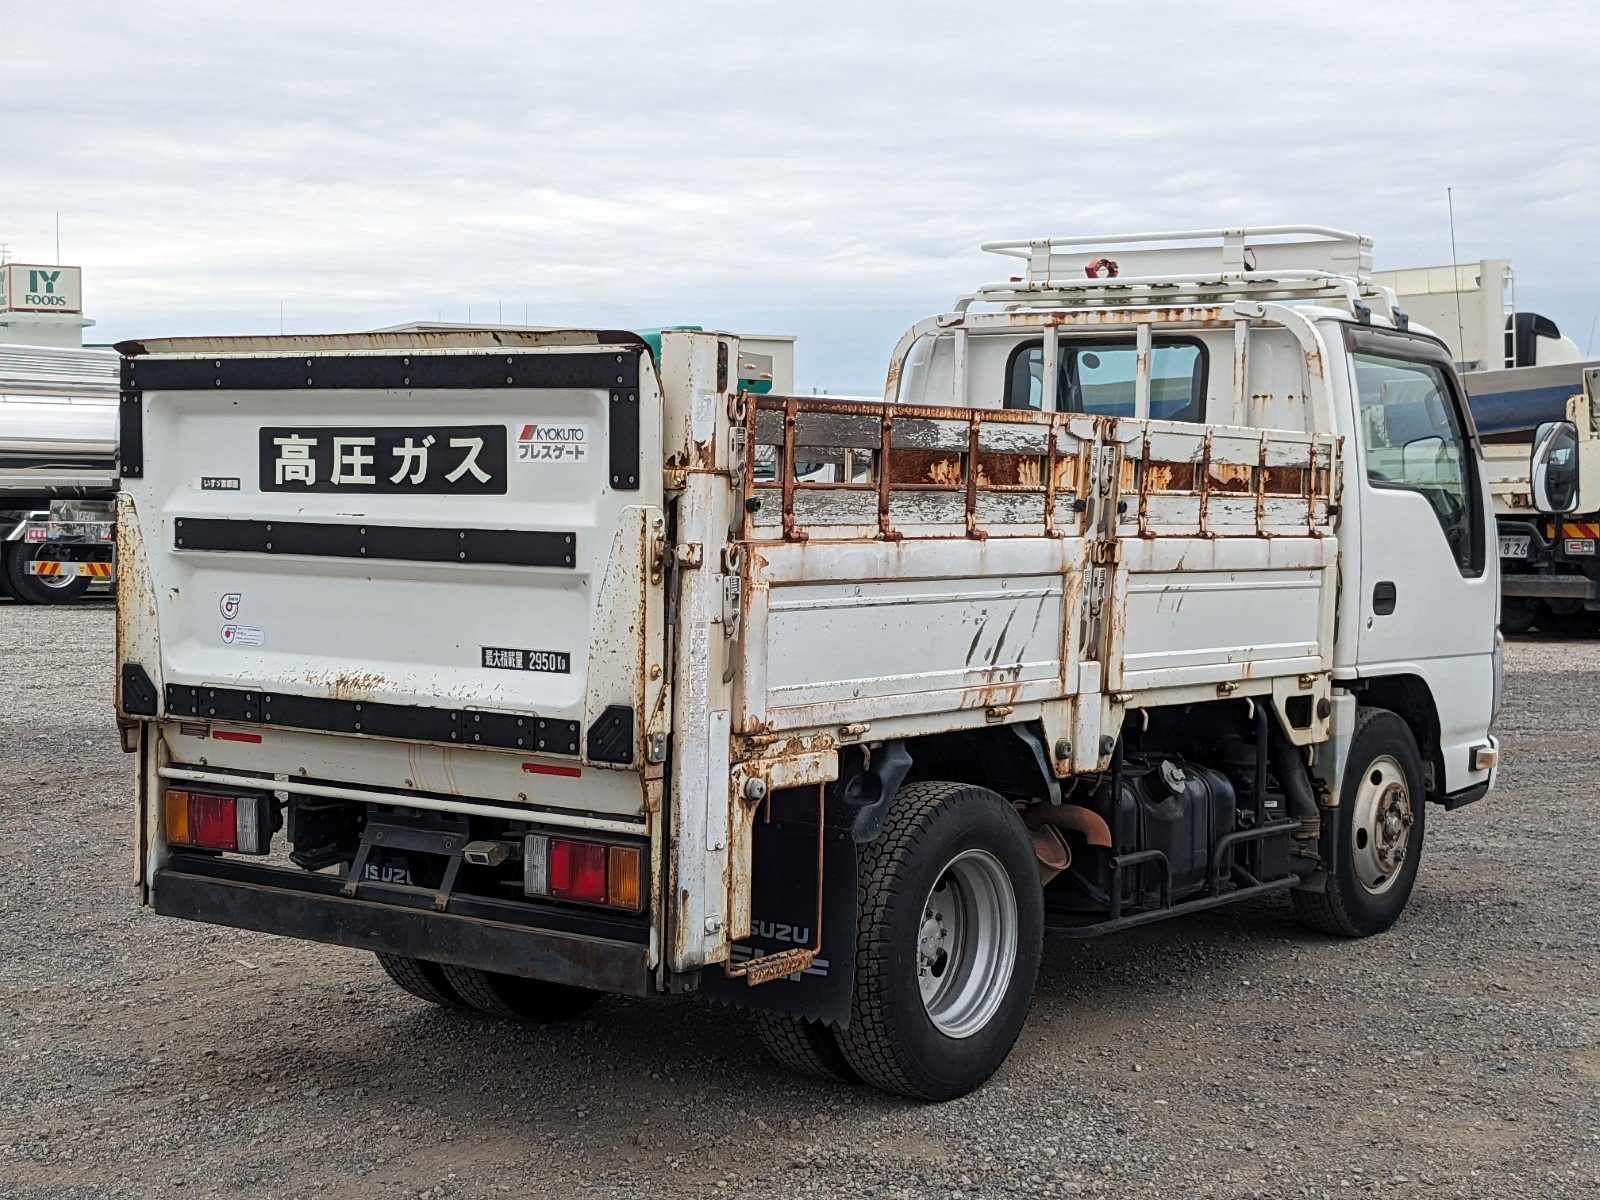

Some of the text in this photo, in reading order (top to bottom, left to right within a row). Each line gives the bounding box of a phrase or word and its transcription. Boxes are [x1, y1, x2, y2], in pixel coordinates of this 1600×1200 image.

[30, 270, 61, 293] IY
[25, 295, 66, 306] FOODS
[537, 428, 584, 441] KYOKUTO
[273, 433, 492, 487] 高圧ガス
[518, 444, 585, 460] プレスゲート
[485, 650, 523, 669] 最大積載量
[750, 919, 809, 944] SUZU
